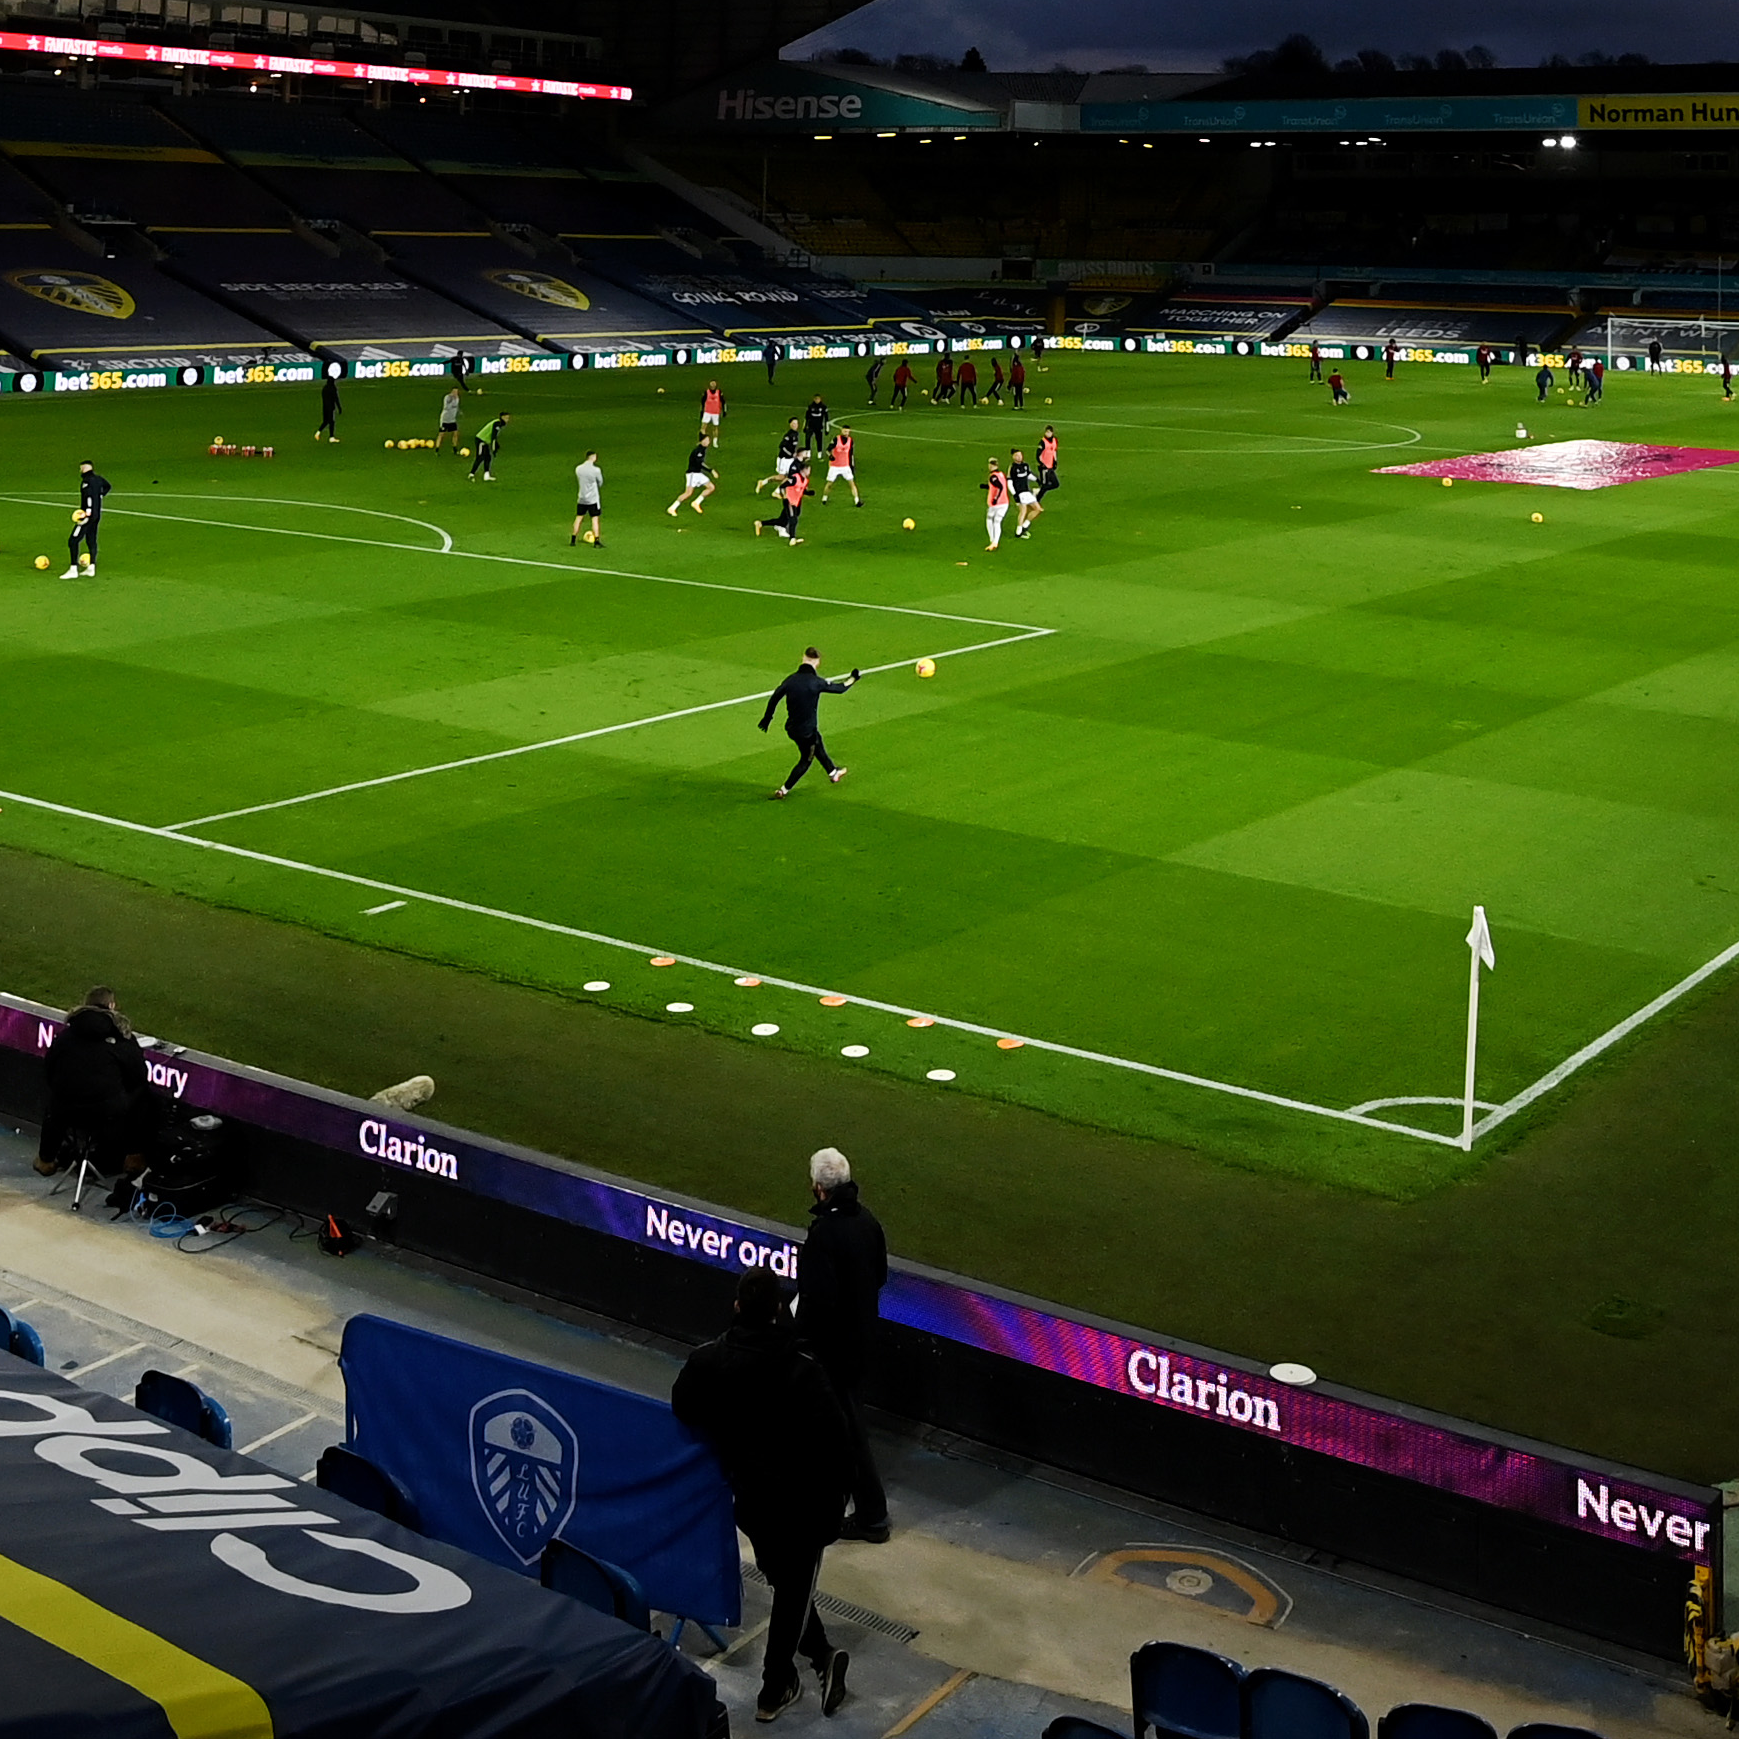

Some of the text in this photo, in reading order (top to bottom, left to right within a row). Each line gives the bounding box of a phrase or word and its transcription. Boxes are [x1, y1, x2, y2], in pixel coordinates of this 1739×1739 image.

[717, 89, 863, 122] Hisense
[1588, 103, 1683, 122] Norman
[1377, 327, 1462, 339] LEEDS
[789, 344, 850, 360] bet365.com
[874, 340, 930, 357] bet365.com
[951, 336, 1003, 352] bet365.com
[1146, 338, 1226, 355] bet365.com
[481, 355, 562, 375] bet365.com
[594, 351, 667, 371] bet365.com
[696, 347, 763, 364] bet365.com
[213, 364, 314, 385] bet365.com
[354, 359, 445, 380] bet365.com
[54, 371, 167, 392] bet365.com
[360, 1117, 459, 1181] Clarion
[645, 1203, 798, 1279] Never ordi
[1126, 1350, 1281, 1432] Clarion
[510, 1462, 536, 1540] LUFC
[1576, 1477, 1710, 1553] Never
